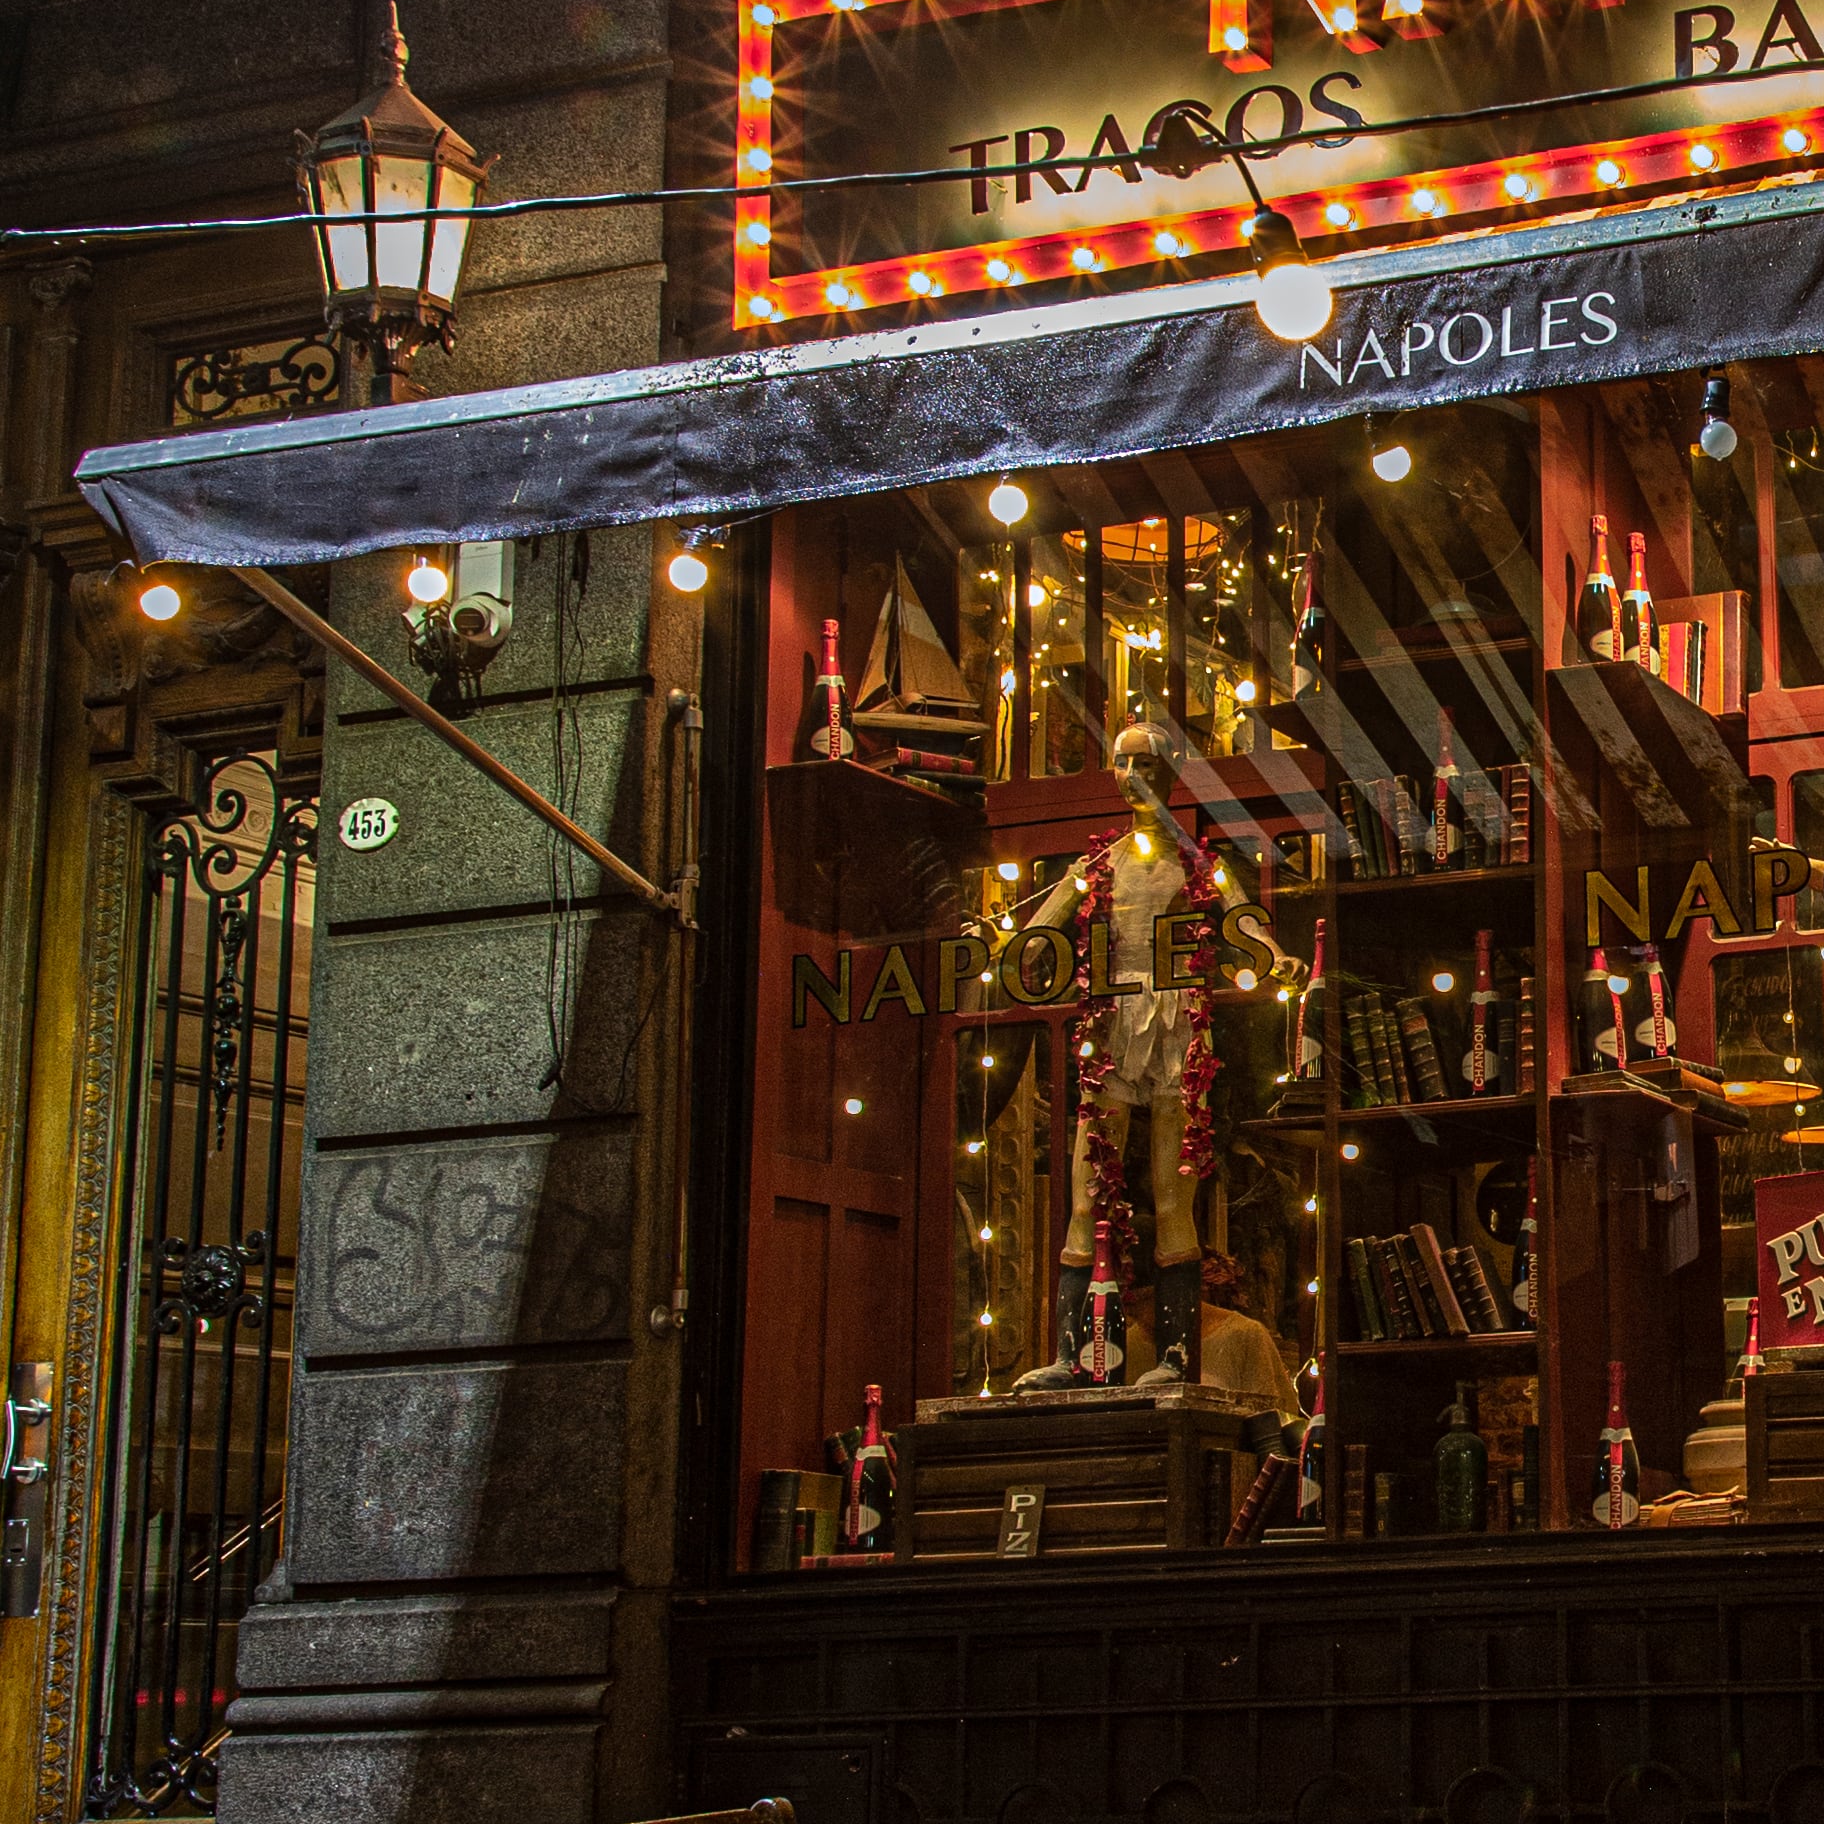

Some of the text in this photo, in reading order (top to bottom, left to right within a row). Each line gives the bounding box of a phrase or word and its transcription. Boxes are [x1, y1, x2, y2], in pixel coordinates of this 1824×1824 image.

[1299, 291, 1618, 390] NAPOLES
[1612, 605, 1621, 662] HANDON
[830, 703, 842, 760] CHANDON
[347, 809, 387, 840] 453
[1436, 799, 1447, 860] CHANDON
[792, 902, 1275, 1029] NAPOLES
[1652, 992, 1667, 1053] CHANDON
[1474, 1024, 1486, 1087] CHANDON
[1528, 1253, 1539, 1318] CHANDON
[1781, 1286, 1806, 1319] E
[1094, 1316, 1106, 1378] CHANDON
[1610, 1464, 1622, 1528] CHANDON
